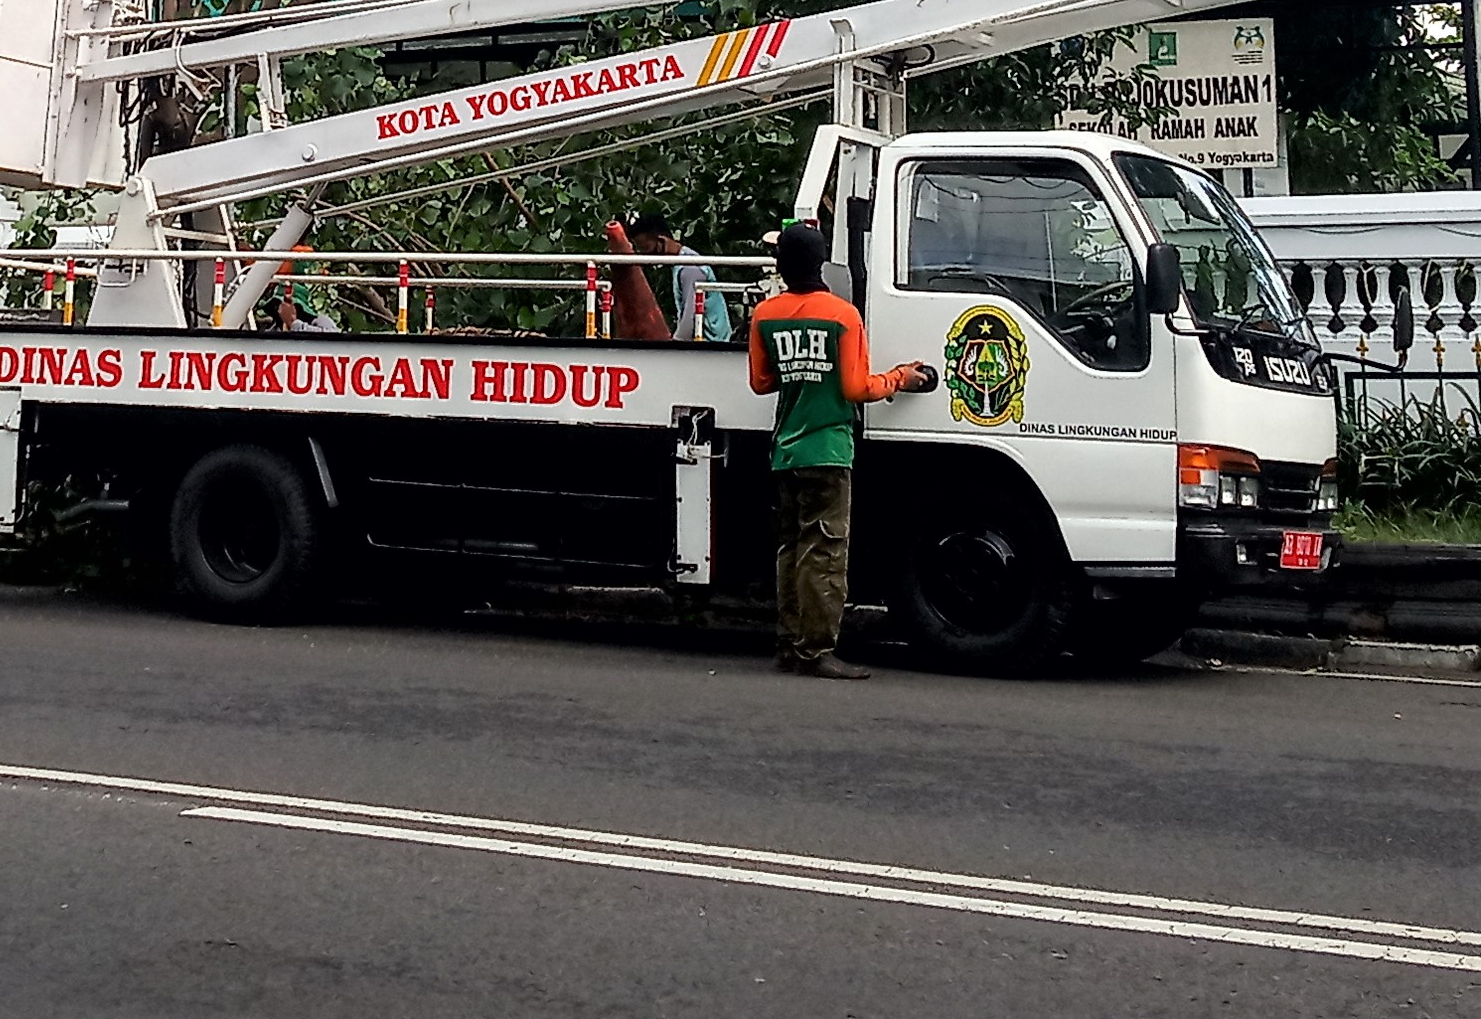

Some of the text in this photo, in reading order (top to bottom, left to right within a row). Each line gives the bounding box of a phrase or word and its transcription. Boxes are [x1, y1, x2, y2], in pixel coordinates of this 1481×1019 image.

[376, 55, 685, 140] KOTA YOGYAKARTA
[1105, 75, 1258, 108] JOKUSUMAN
[1262, 74, 1272, 102] 1
[1151, 118, 1205, 140] RAMAH
[1214, 116, 1258, 138] ANAK
[1208, 150, 1274, 166] Yogyakarta
[773, 329, 828, 361] DLH
[138, 349, 454, 400] LINGKUNGAN
[470, 359, 640, 409] HIDUP
[1263, 355, 1311, 386] ISUZU
[1019, 423, 1178, 440] DINAS LINGKUNGAN HIDUP
